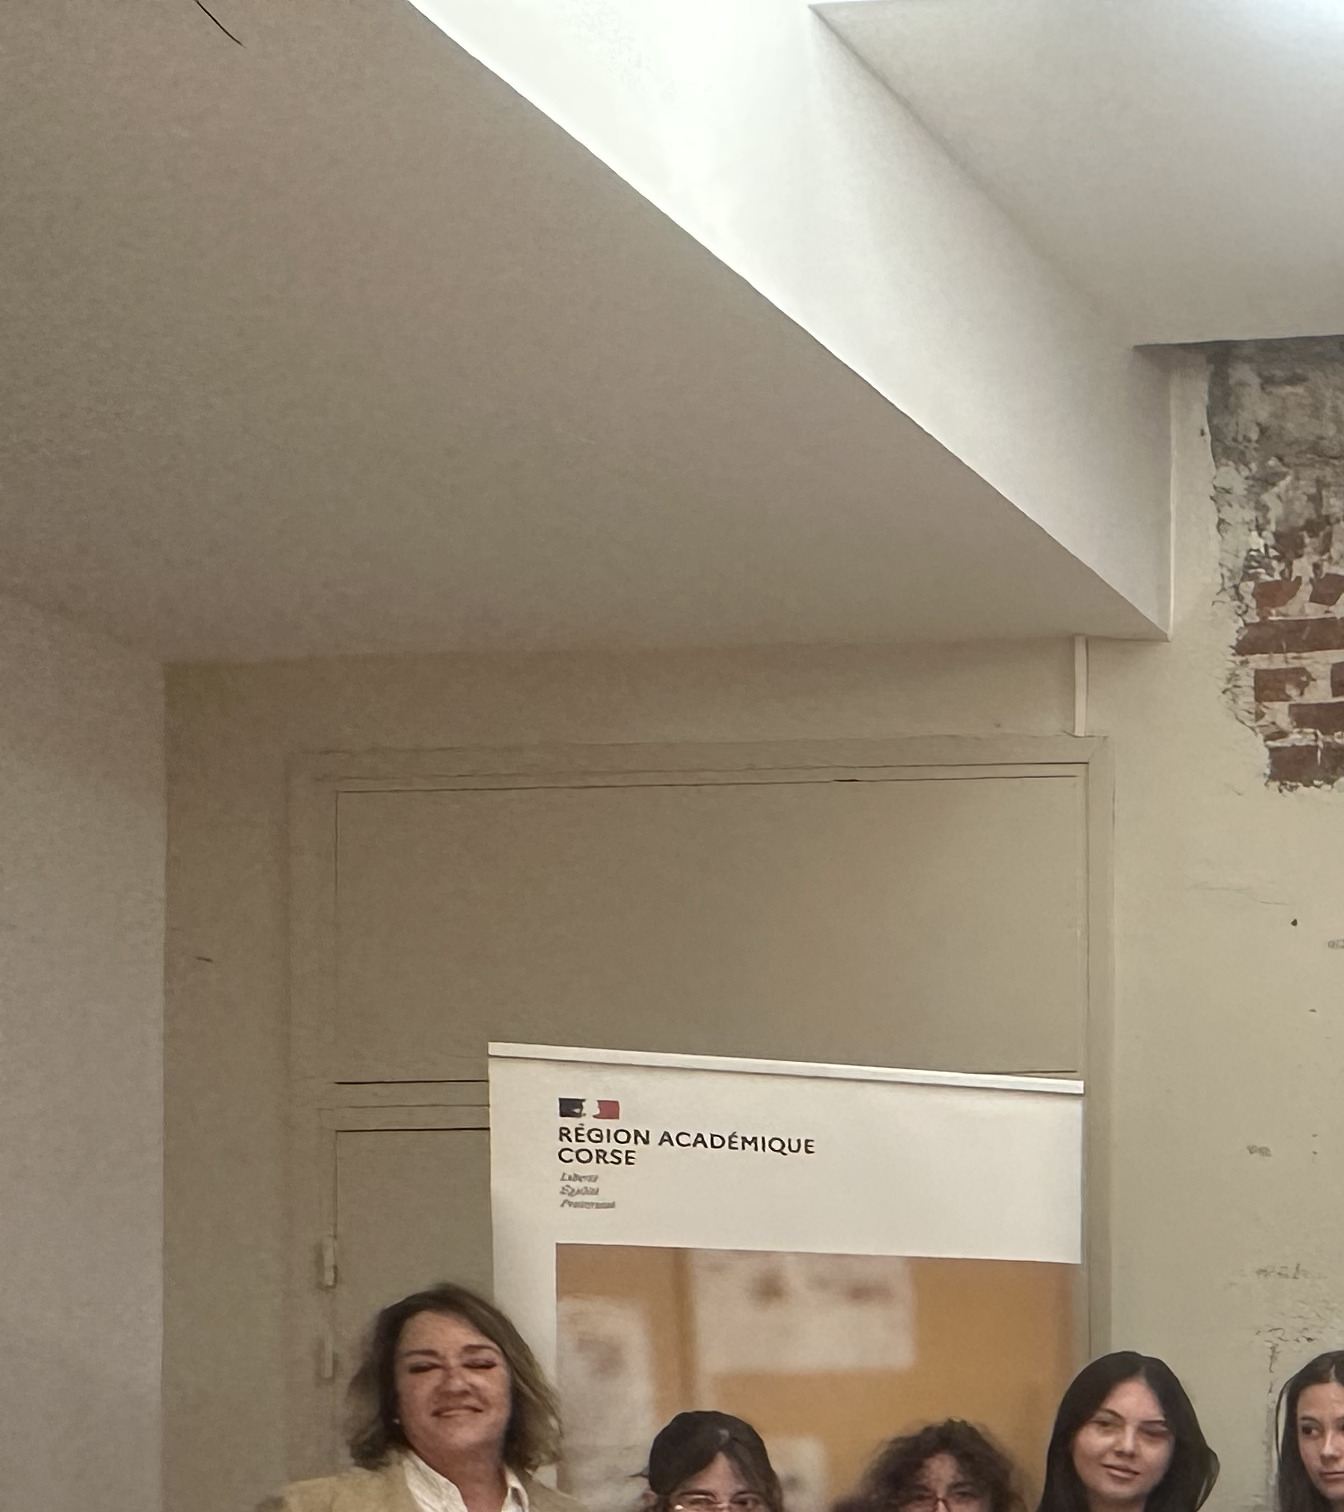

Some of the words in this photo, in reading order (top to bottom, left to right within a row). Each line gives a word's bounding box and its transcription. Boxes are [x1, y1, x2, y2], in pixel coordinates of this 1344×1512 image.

[557, 1123, 651, 1146] RÉGION
[657, 1131, 816, 1156] ACADÉMIQUE
[557, 1147, 637, 1166] CORSE
